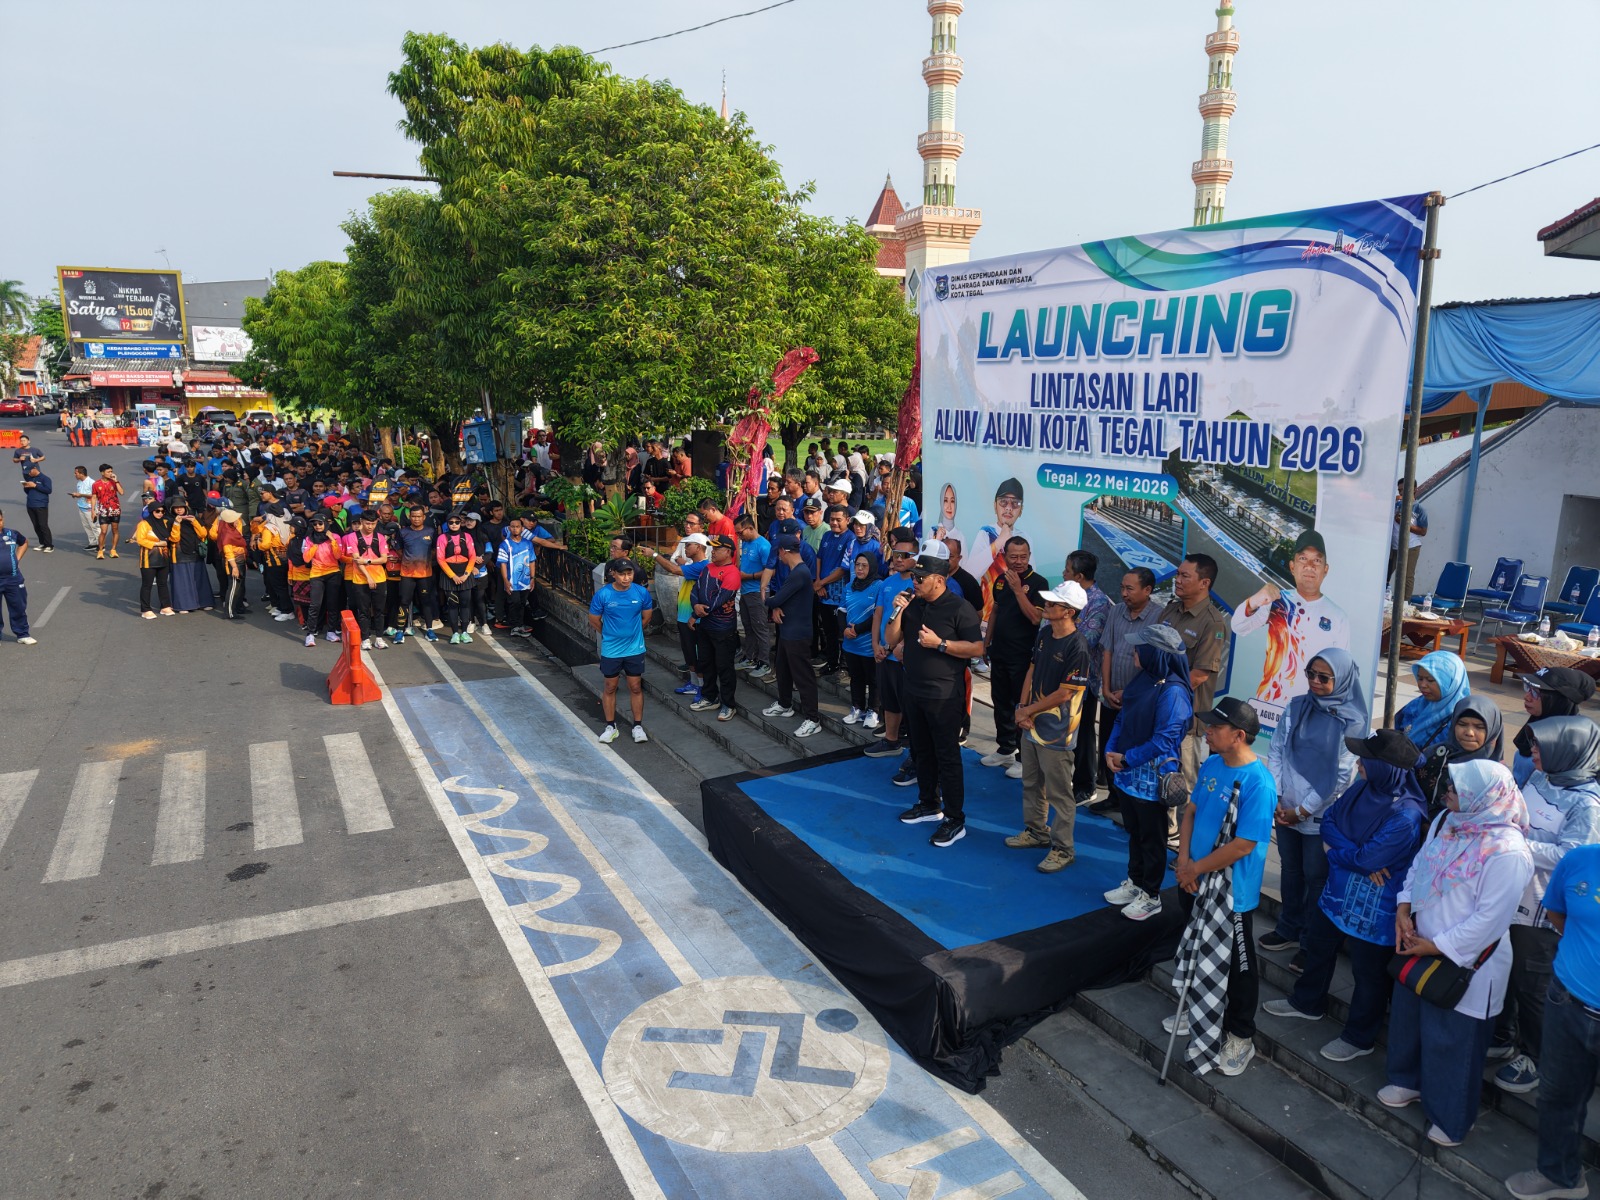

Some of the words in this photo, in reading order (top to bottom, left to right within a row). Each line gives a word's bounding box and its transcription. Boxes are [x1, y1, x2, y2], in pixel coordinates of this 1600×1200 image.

[1355, 232, 1390, 257] Tegal
[950, 274, 968, 283] DINAS
[968, 269, 1008, 281] KEPEMUDAAN
[1009, 267, 1022, 275] DAN
[950, 282, 981, 290] OLAHRAGA
[982, 280, 995, 288] DAN
[995, 275, 1033, 286] PARIWISATA
[950, 291, 966, 299] KOTA
[966, 289, 984, 297] TEGAL
[68, 300, 117, 320] Satya
[121, 321, 131, 330] 12
[976, 287, 1294, 360] LAUNCHING
[1030, 372, 1134, 411] LINTASAN
[1143, 372, 1199, 413] LARI
[934, 408, 979, 443] ALUN
[982, 411, 1032, 448] ALUN
[1040, 414, 1090, 451] KOTA
[1098, 415, 1169, 459] TEGAL
[1178, 419, 1271, 467] TAHUN
[1281, 423, 1363, 472] 2026
[1044, 468, 1081, 488] Tegal,
[1085, 472, 1101, 488] 22
[1105, 475, 1128, 491] Mei
[1132, 477, 1169, 496] 2026
[1260, 709, 1275, 720] AGUS
